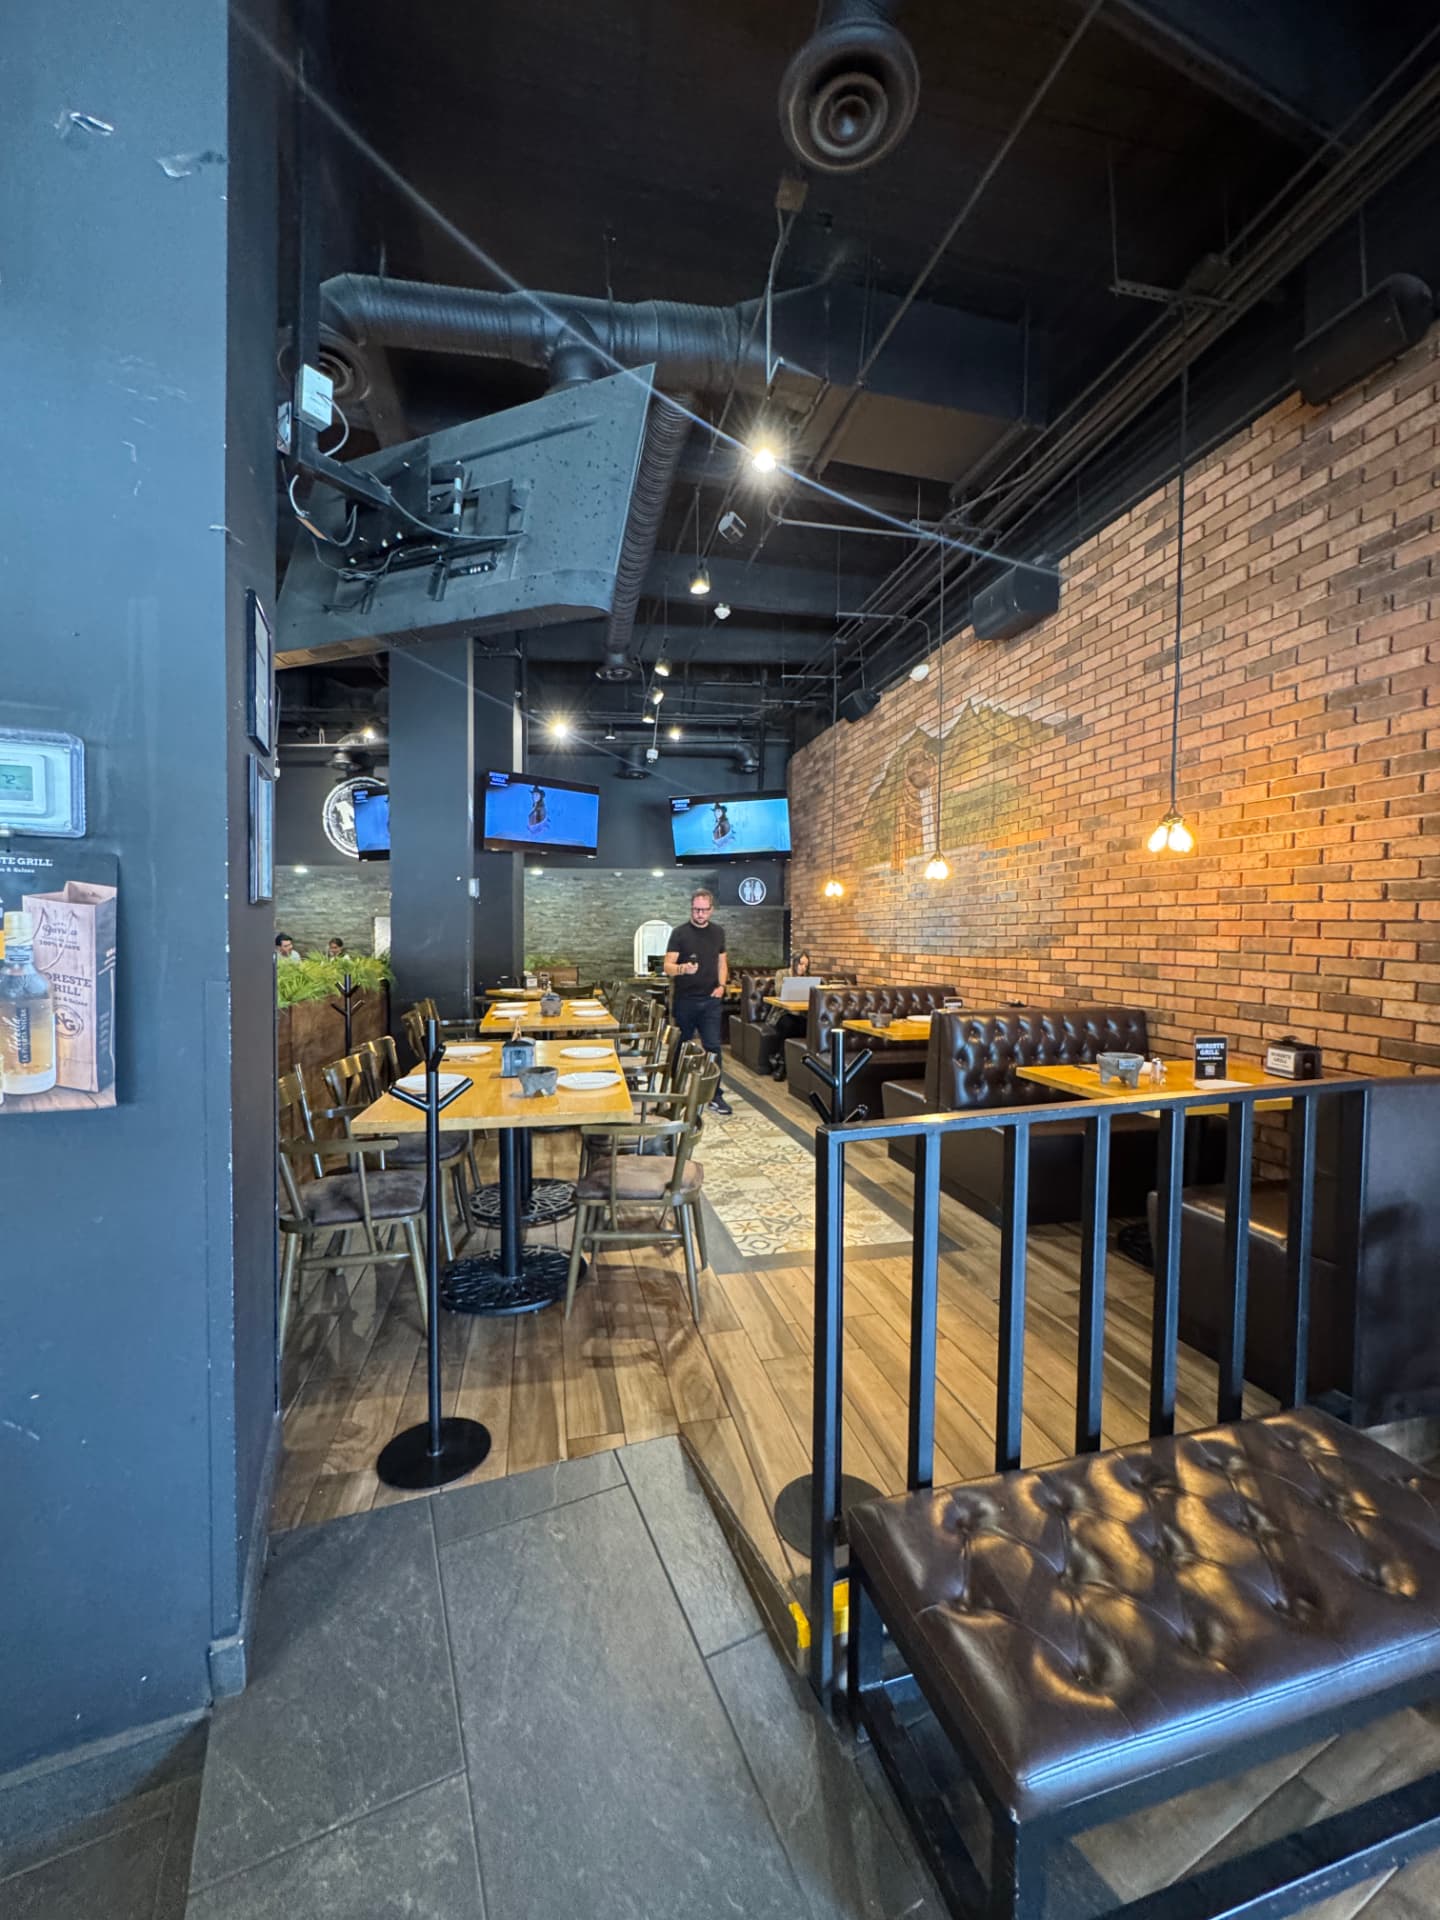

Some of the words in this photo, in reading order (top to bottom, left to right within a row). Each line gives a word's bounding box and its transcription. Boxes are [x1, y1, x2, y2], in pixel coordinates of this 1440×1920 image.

[0, 856, 16, 865] TE
[17, 857, 53, 867] GRILL
[44, 971, 93, 988] ORESTE
[53, 983, 81, 996] RILL
